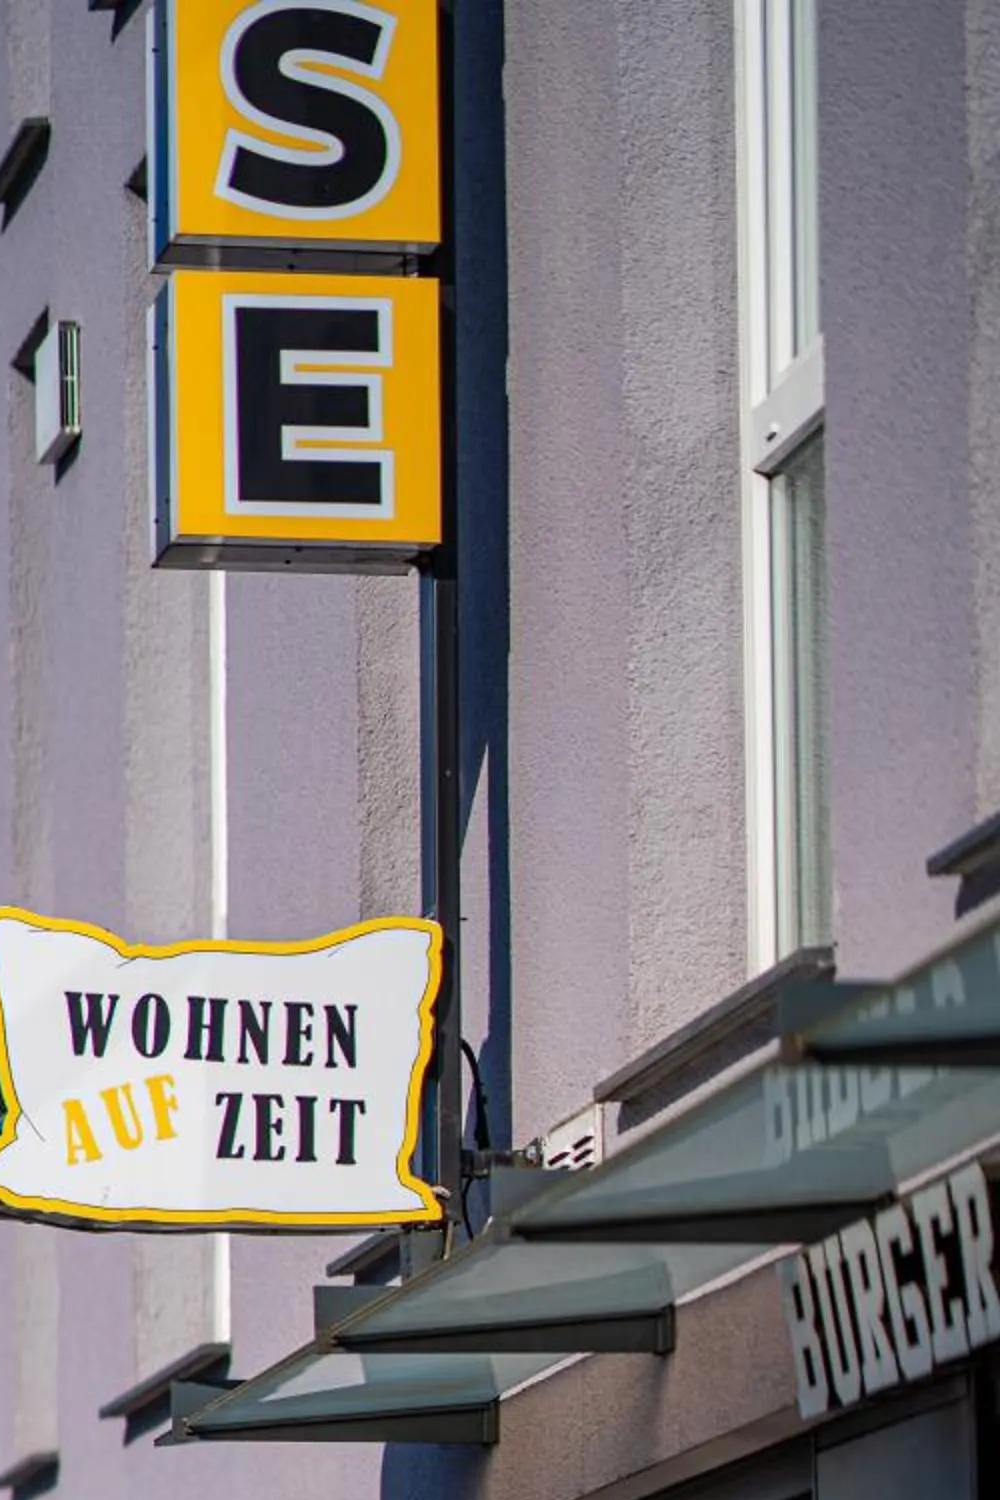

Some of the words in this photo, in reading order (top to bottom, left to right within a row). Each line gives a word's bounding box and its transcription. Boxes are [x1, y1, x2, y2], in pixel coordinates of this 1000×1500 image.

[63, 990, 359, 1069] WOHNEN
[61, 1073, 180, 1166] AUF
[215, 1091, 367, 1166] ZEIT
[780, 1160, 1000, 1420] BURGER
